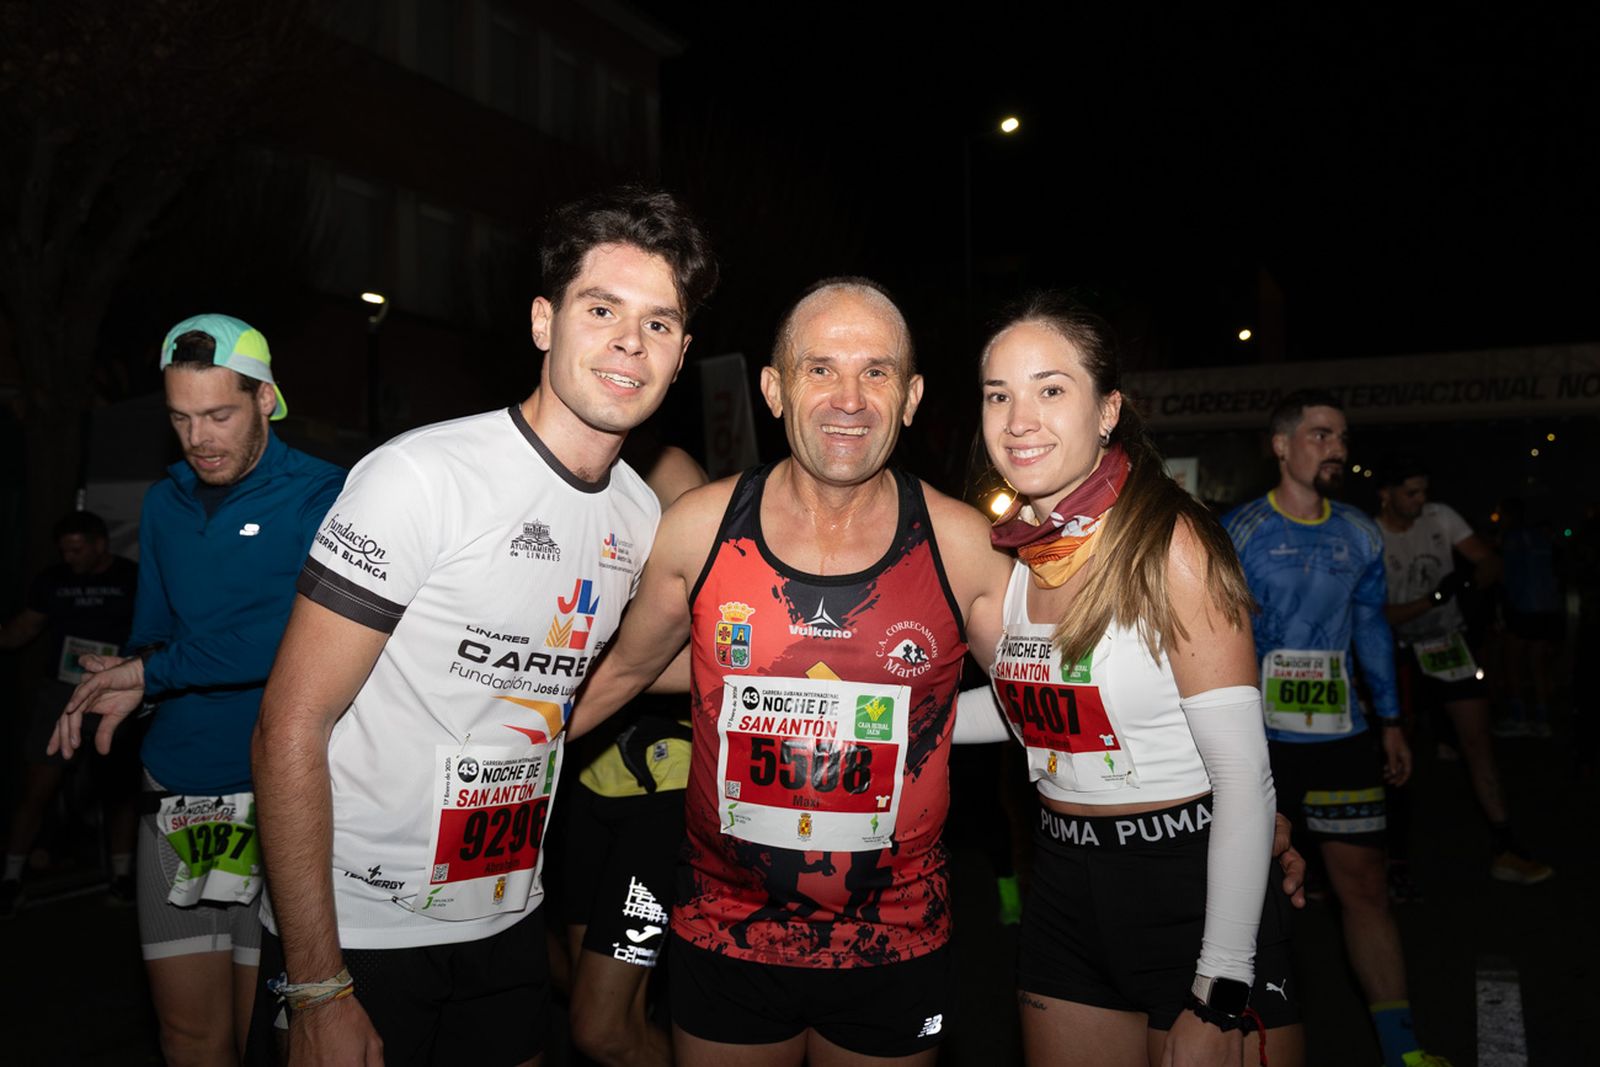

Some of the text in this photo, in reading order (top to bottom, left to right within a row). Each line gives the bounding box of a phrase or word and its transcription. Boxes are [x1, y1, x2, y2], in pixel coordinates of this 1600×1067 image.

[1161, 388, 1283, 416] CARRERA
[1312, 375, 1546, 408] TERNACIONAL
[510, 541, 561, 555] AYUNTAMIENTO
[526, 552, 560, 562] LINARES
[341, 550, 387, 581] BLANCA
[466, 625, 530, 645] LINARES
[789, 624, 853, 639] Vulkano
[886, 620, 938, 659] CORRECAMINOS
[457, 639, 588, 678] CARRE
[1006, 642, 1052, 659] NOCHE DE
[449, 661, 576, 697] Fundación José Lui
[883, 658, 931, 678] Martos
[996, 659, 1050, 682] SAN ANTÓN
[743, 691, 759, 705] 43
[1280, 680, 1339, 705] 6026
[762, 696, 840, 716] NOCHE DE
[739, 715, 838, 738] SAN ANTÓN
[458, 763, 478, 776] 43
[481, 762, 541, 784] NOCHE DE
[750, 737, 873, 795] 5508
[456, 780, 537, 807] SAN ANTÓN
[793, 795, 819, 808] Maxi
[460, 801, 548, 861] 9296
[1041, 803, 1213, 846] PUMA PUMA
[188, 823, 254, 864] 1287
